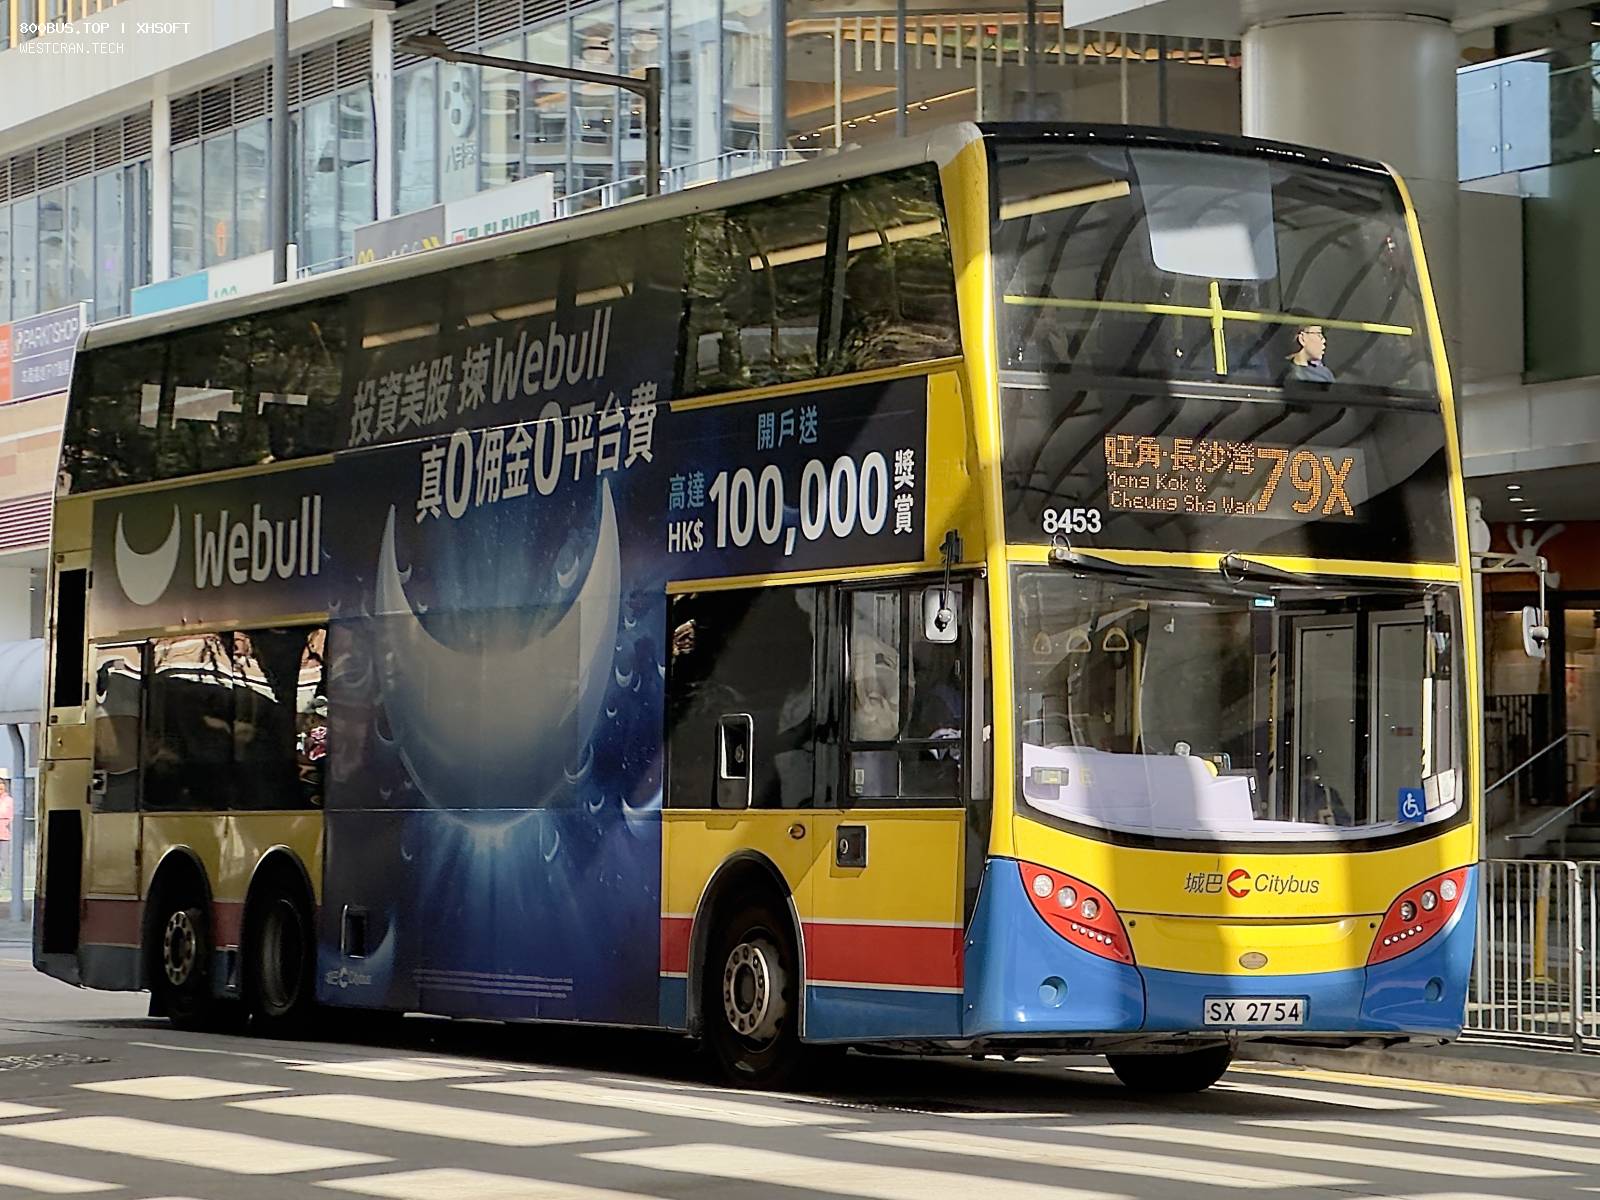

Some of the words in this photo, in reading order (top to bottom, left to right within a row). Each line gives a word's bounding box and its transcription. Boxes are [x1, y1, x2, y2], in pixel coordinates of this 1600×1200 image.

[668, 471, 705, 512] 高達
[1156, 473, 1189, 491] Kok
[1195, 475, 1207, 493] &
[1257, 447, 1354, 516] 79X
[667, 517, 704, 553] HK$
[708, 451, 889, 556] 100,000
[1111, 490, 1177, 511] Cheung
[1183, 494, 1216, 514] Sha
[1222, 496, 1255, 515] Wan
[1043, 508, 1101, 534] 8453
[193, 494, 322, 590] Webull
[1184, 872, 1223, 894] 城巴
[1254, 873, 1320, 895] Citybus
[1209, 1002, 1236, 1022] SX
[1246, 1002, 1299, 1022] 2754
